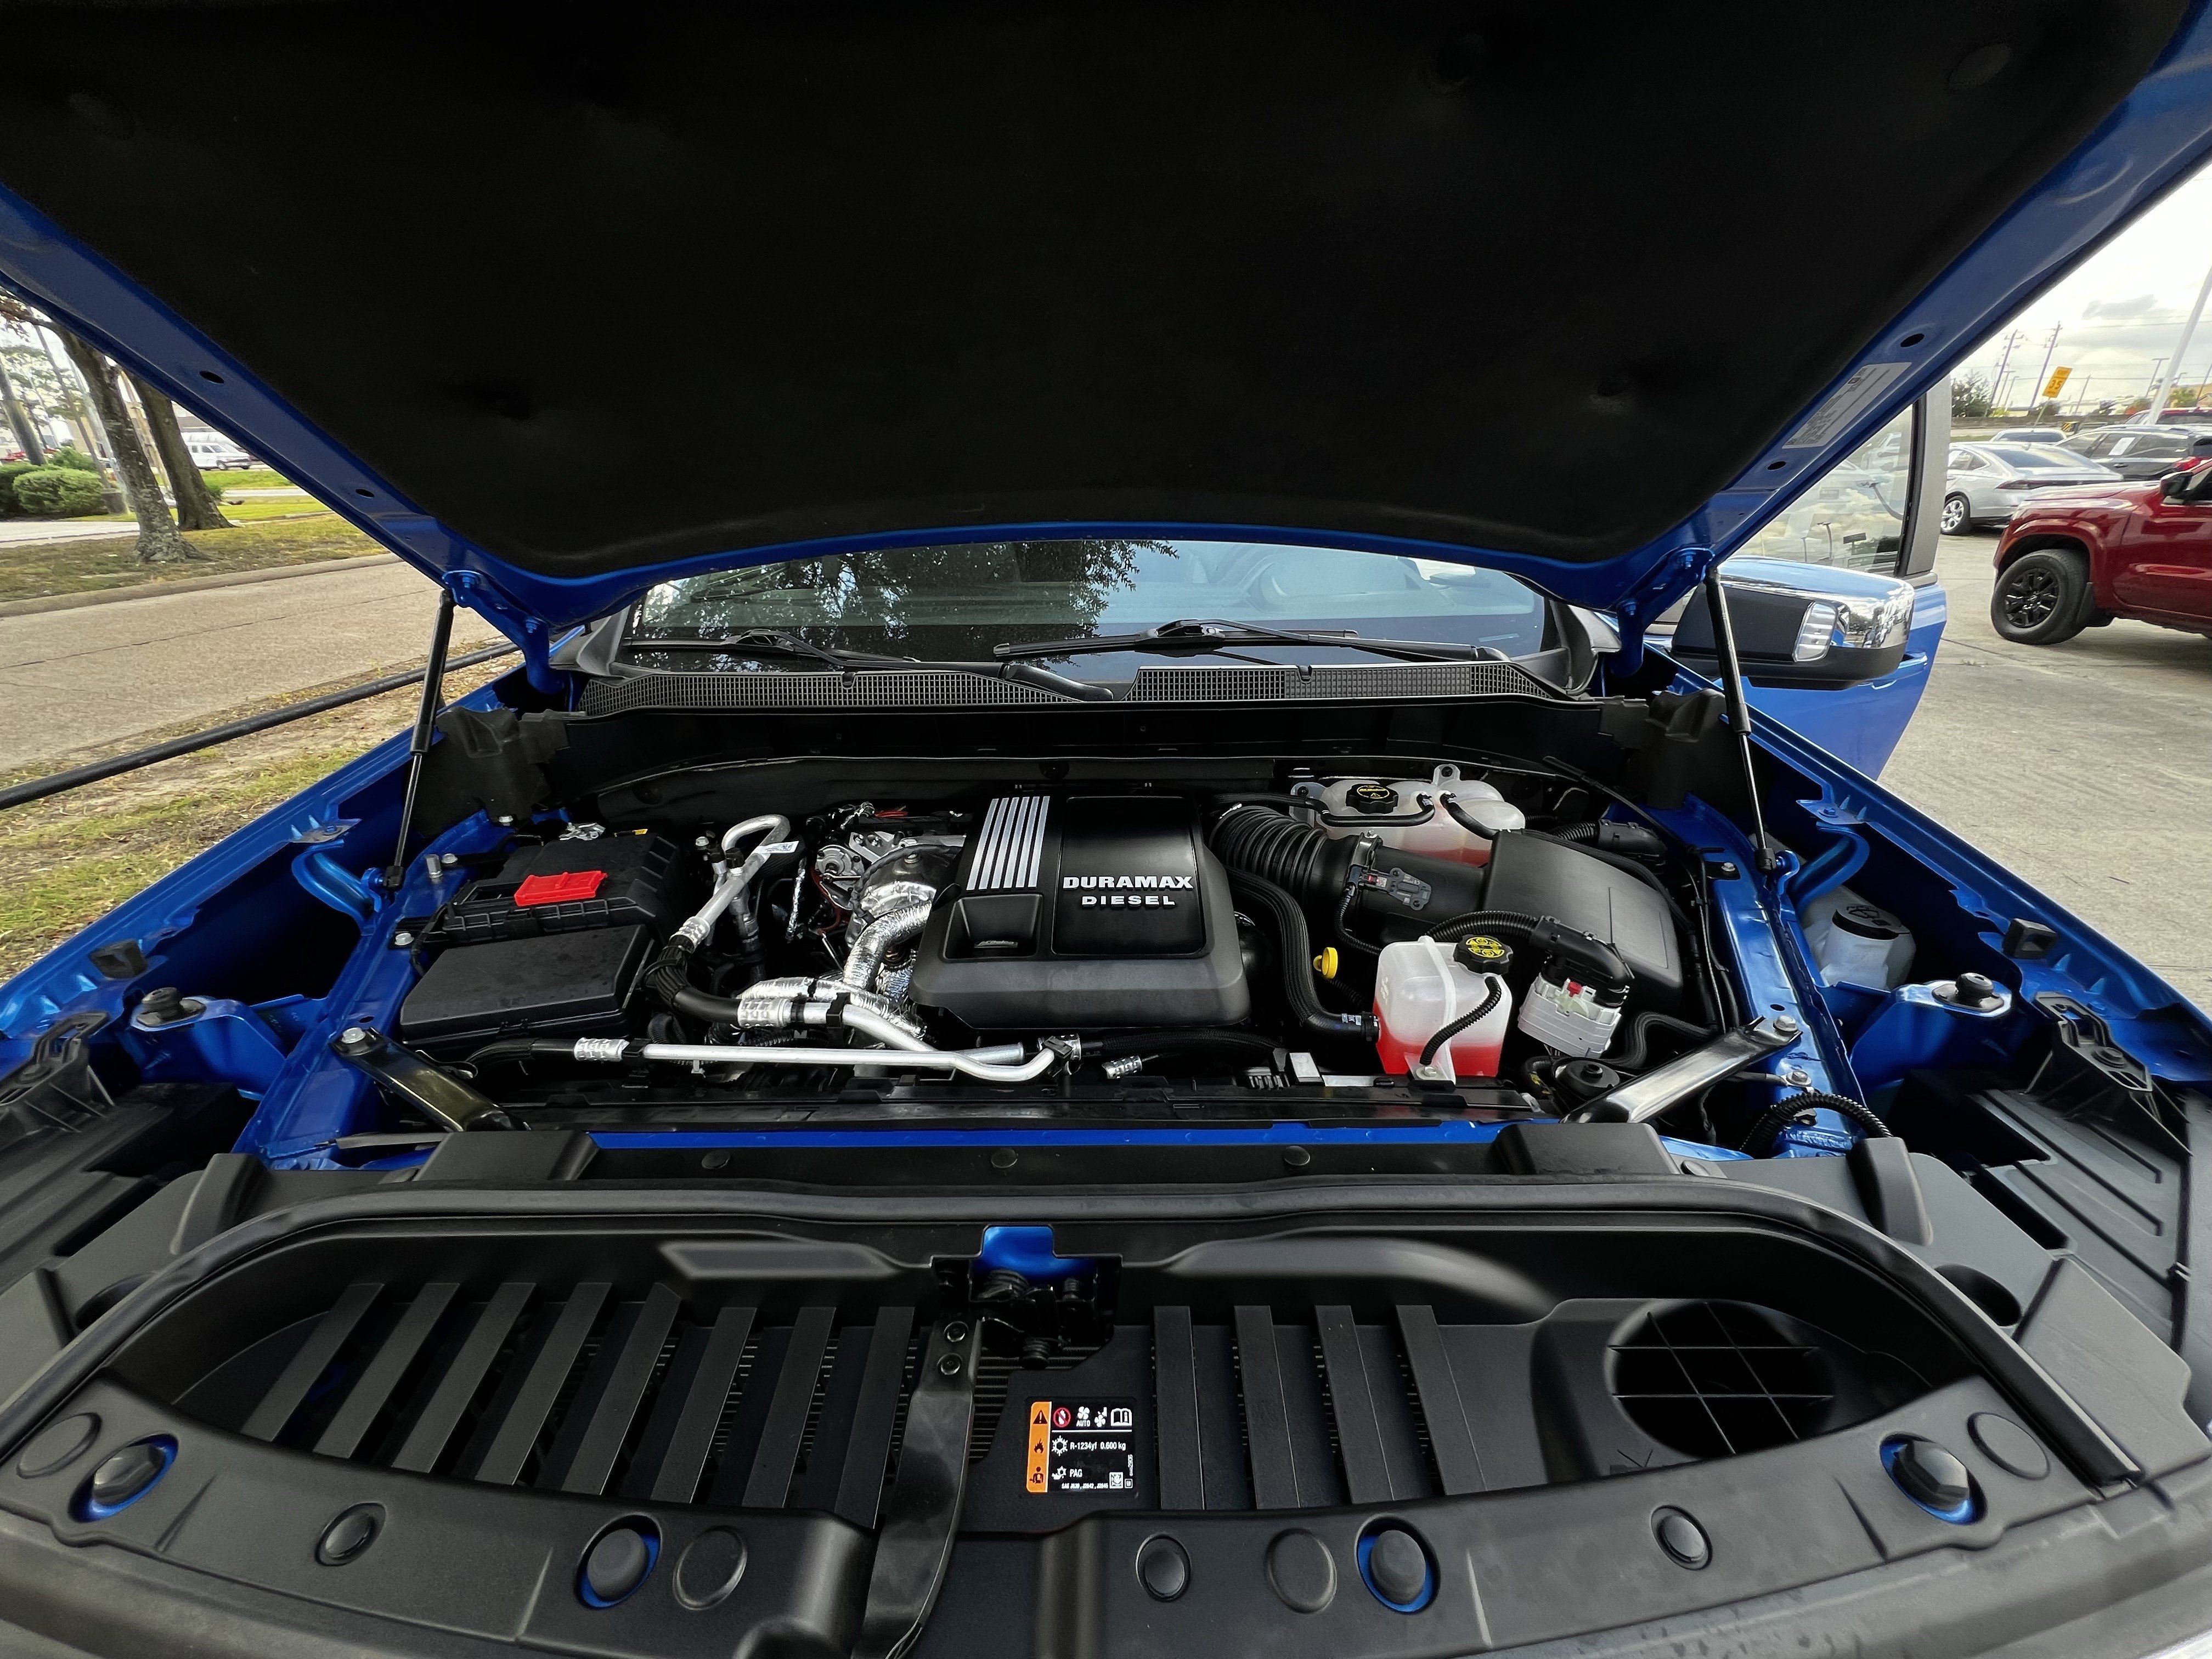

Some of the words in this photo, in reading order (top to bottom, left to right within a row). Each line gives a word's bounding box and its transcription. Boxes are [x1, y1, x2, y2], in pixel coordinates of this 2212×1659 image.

[1063, 876, 1194, 889] DURAMAX
[1082, 895, 1175, 906] DIESEL
[1070, 1442, 1097, 1451] R-1234yf
[1100, 1441, 1117, 1450] 0.600
[1118, 1441, 1126, 1451] kg
[1070, 1469, 1082, 1477] PAG
